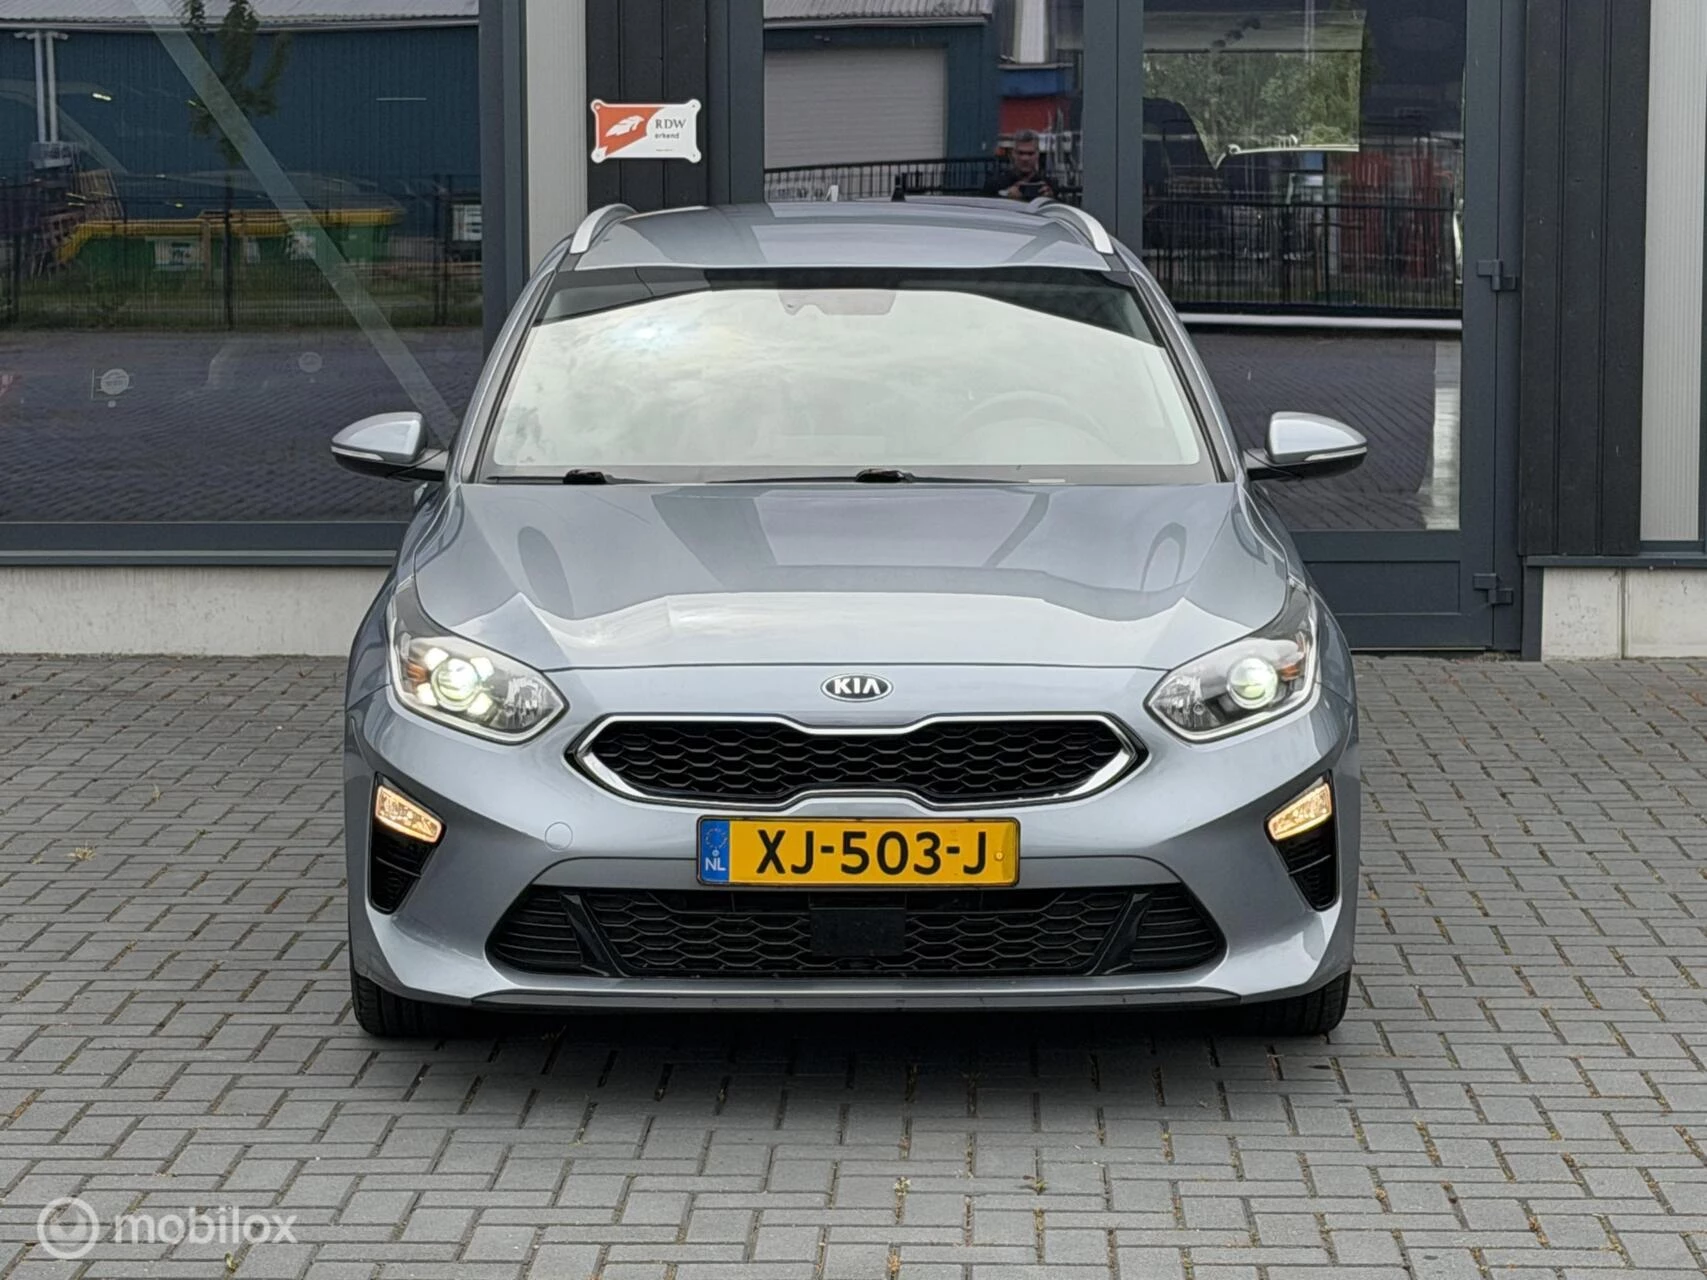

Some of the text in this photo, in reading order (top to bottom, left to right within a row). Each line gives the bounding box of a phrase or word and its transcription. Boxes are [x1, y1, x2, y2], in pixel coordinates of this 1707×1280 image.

[655, 119, 687, 129] RDW
[834, 677, 880, 695] KIA
[756, 829, 987, 876] XJ-503-J
[705, 857, 726, 871] NL
